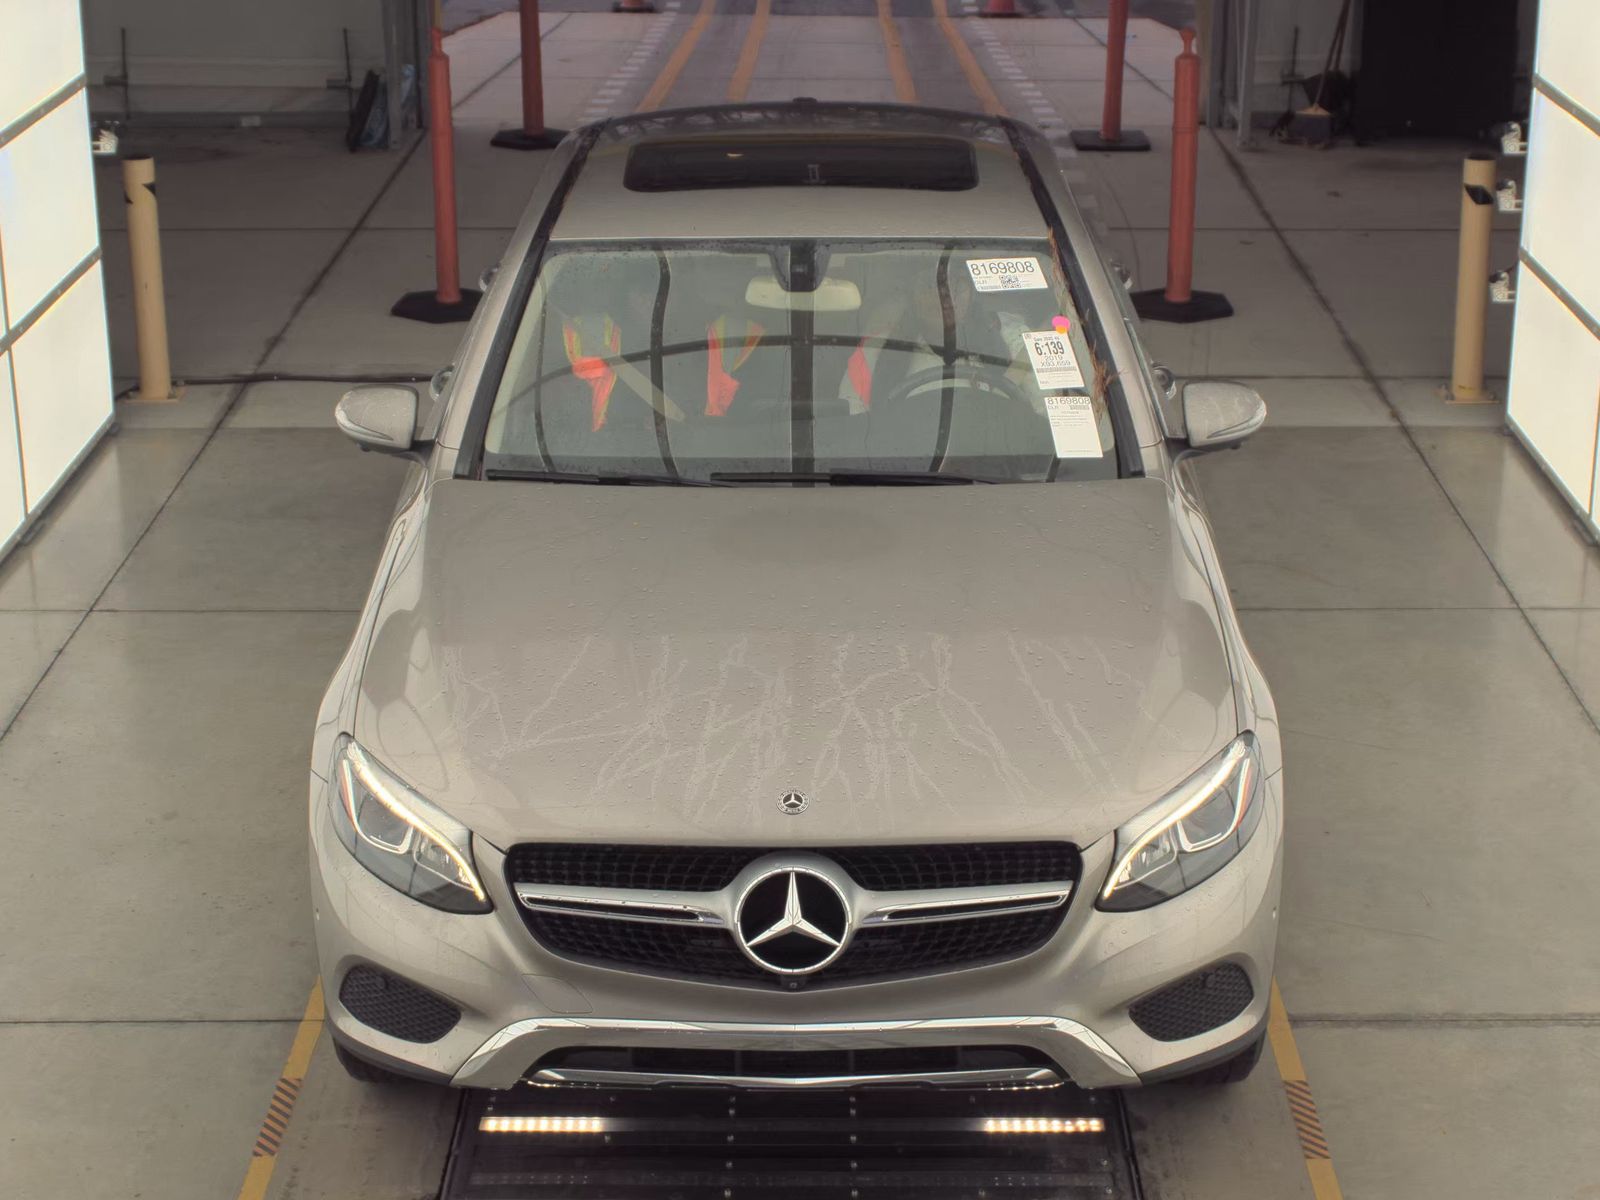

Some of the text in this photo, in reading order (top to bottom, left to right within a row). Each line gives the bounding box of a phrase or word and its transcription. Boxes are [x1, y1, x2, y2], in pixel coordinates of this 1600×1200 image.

[970, 261, 1035, 275] 8169808
[1034, 341, 1064, 356] 6:139
[1047, 397, 1091, 405] 8169808
